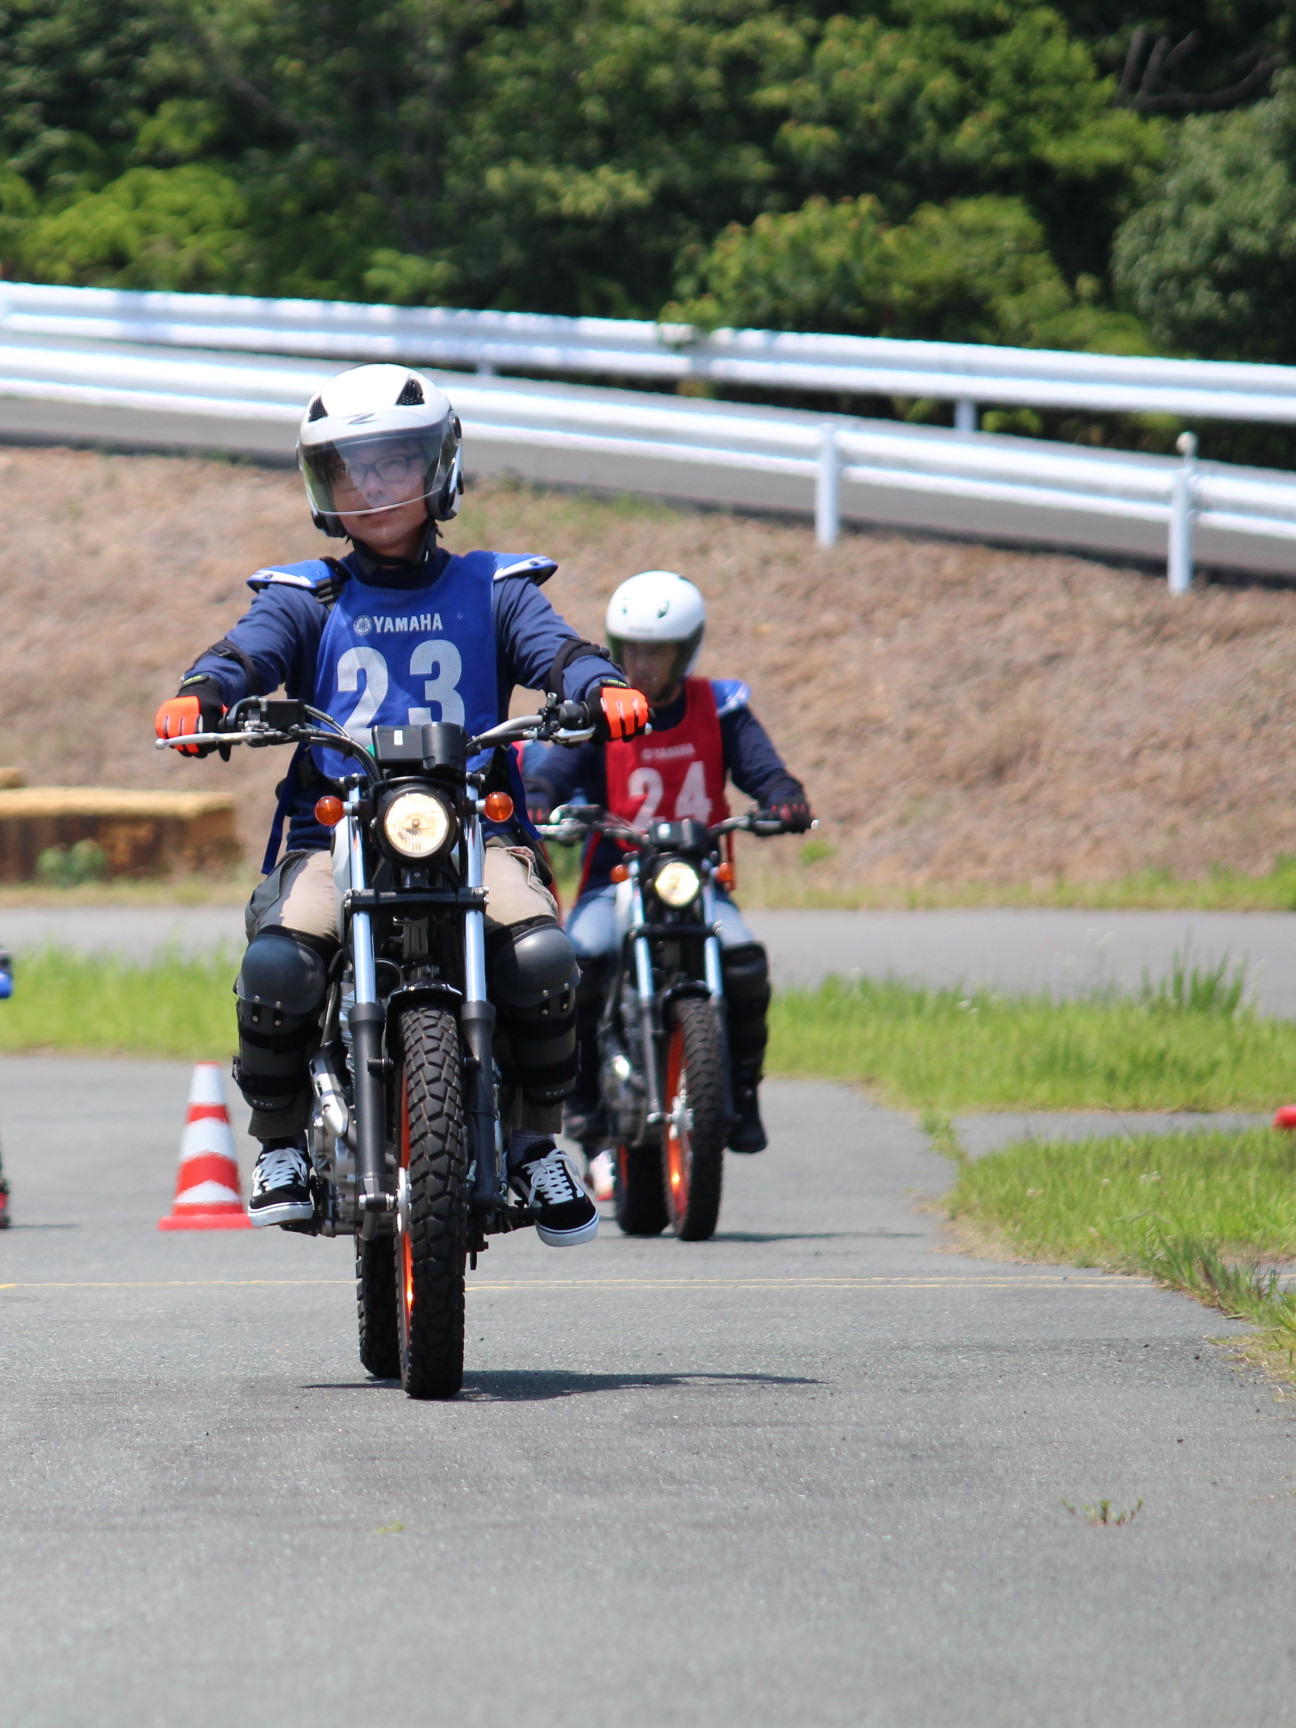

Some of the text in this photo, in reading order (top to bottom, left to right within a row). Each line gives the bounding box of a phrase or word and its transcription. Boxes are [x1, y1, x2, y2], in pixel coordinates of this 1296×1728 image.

[373, 612, 443, 633] YAMAHA
[337, 639, 465, 748] 23
[628, 761, 712, 831] 24
